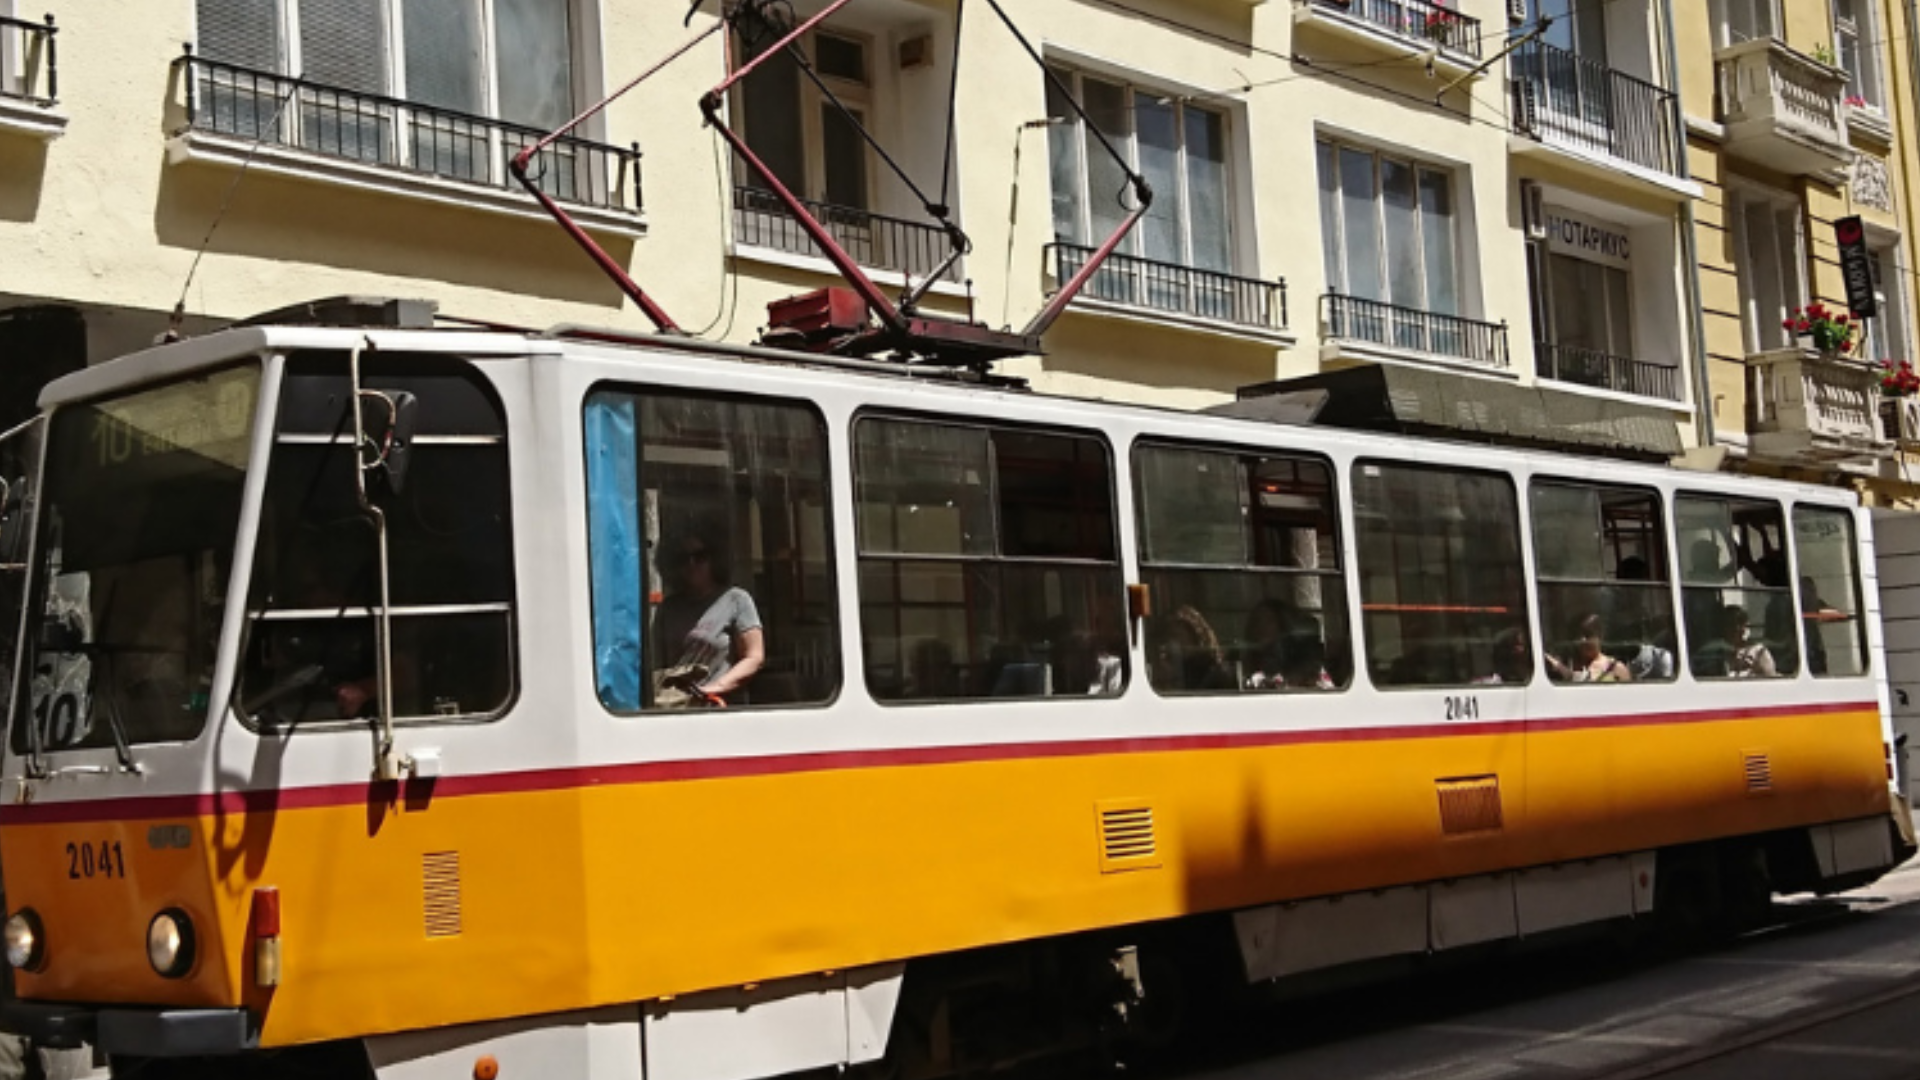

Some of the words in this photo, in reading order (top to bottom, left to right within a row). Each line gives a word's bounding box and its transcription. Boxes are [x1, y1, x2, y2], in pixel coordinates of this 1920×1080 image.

[1548, 214, 1631, 260] НОТАРИУС
[92, 408, 132, 466] 10
[35, 692, 78, 750] 10
[1444, 695, 1479, 720] 2041
[66, 840, 124, 879] 2041
